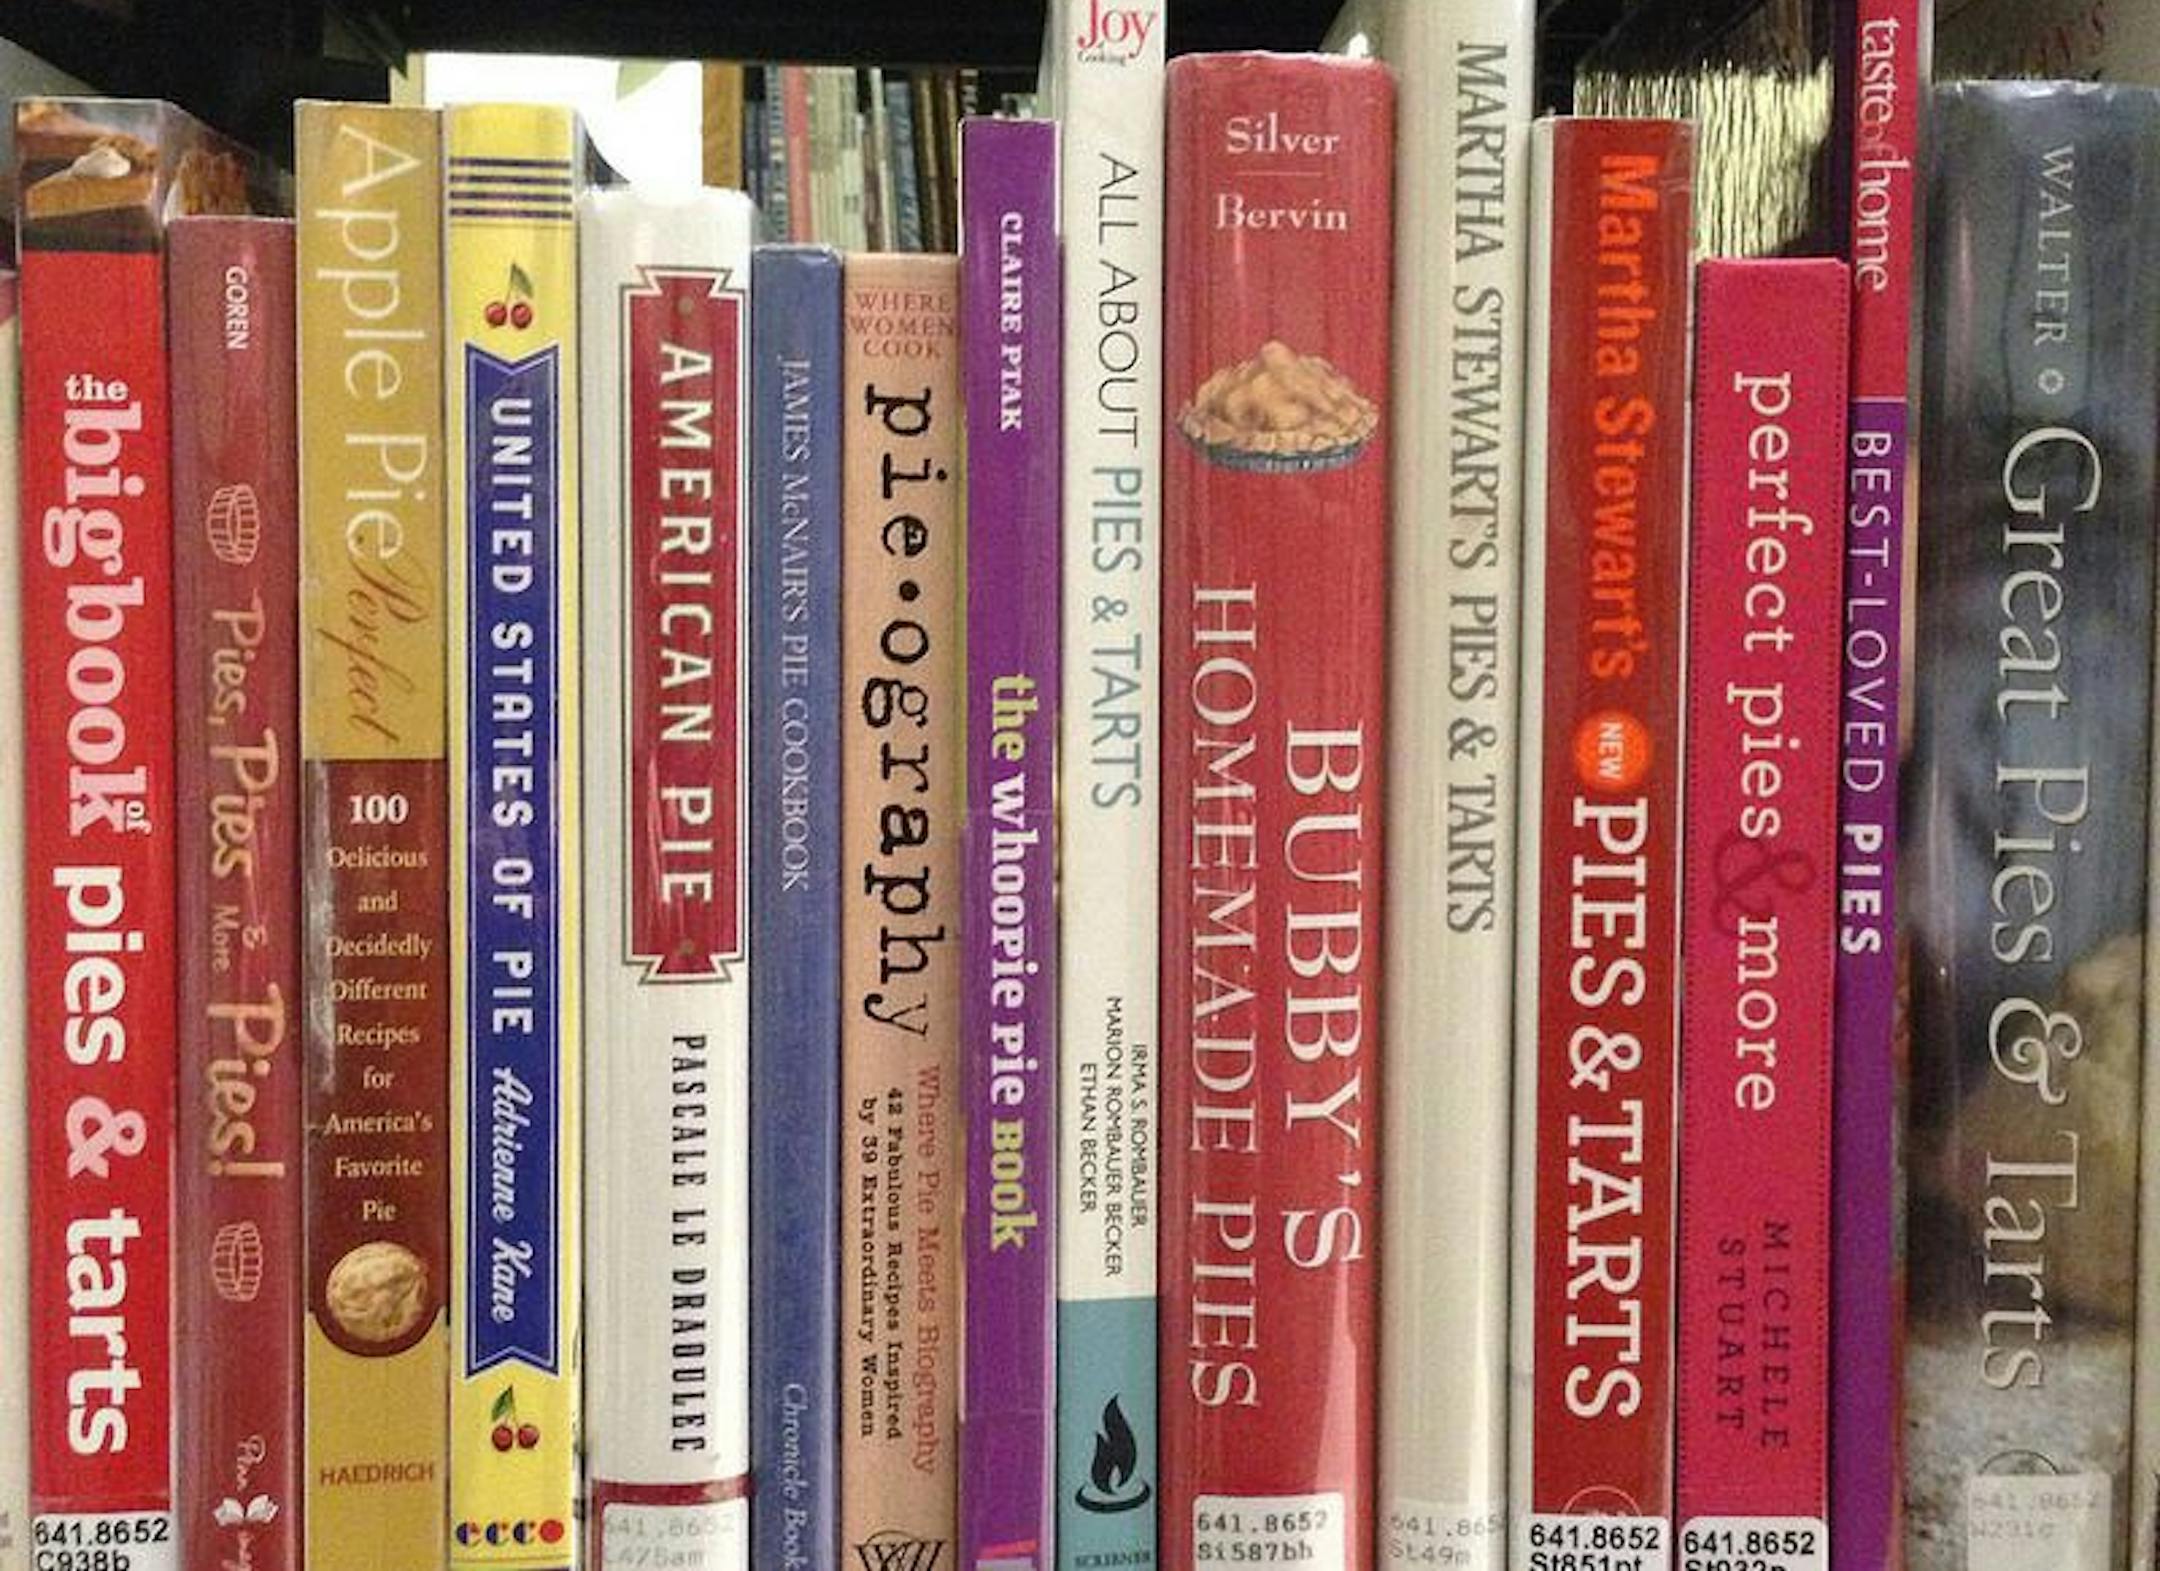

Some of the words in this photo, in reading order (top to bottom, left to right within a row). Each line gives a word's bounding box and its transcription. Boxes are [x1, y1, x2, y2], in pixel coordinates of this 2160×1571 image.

[1077, 0, 1158, 58] Joy
[1225, 113, 1340, 156] Silver
[1454, 43, 1508, 263] MARTHA
[1098, 152, 1139, 245] ALL
[1216, 193, 1348, 233] Bervin
[2032, 145, 2076, 347] WALTER
[225, 264, 250, 350] GOREN
[316, 122, 426, 400] Apple
[855, 291, 951, 313] WHERE
[1001, 211, 1024, 333] CLAIRE
[1598, 154, 1660, 375] Martha
[850, 317, 954, 336] WOMEN
[863, 340, 941, 359] COOK
[1098, 263, 1142, 449] ABOUT
[65, 373, 129, 402] the
[777, 357, 810, 460] JAMES
[1448, 285, 1504, 570] STEWART'S
[344, 431, 428, 558] Pie
[491, 397, 534, 593] UNITED
[660, 342, 714, 744] AMERICAN
[1091, 467, 1144, 573] PIES
[1590, 400, 1656, 680] Stewart's
[1733, 372, 1812, 653] perfect
[1091, 596, 1129, 623] &
[1842, 430, 1893, 794] BEST-LOVED
[1996, 427, 2102, 720] Great
[206, 587, 268, 724] Pies,
[318, 548, 428, 743] Perfect
[781, 632, 809, 688] PIE
[1447, 595, 1499, 707] PIES
[491, 622, 534, 825] STATES
[991, 674, 1038, 760] the
[1091, 632, 1143, 808] TARTS
[1447, 719, 1496, 762] &
[1598, 721, 1625, 783] NEW
[1727, 683, 1801, 838] pies
[208, 727, 280, 878] Pies
[348, 794, 409, 824] 100
[660, 785, 713, 904] PIE
[781, 696, 810, 891] COOKBOOK
[326, 844, 429, 870] Delicious
[357, 890, 399, 914] and
[491, 859, 534, 920] OF
[1191, 581, 1258, 1152] HOMEMADE
[1446, 774, 1498, 935] TARTS
[1570, 797, 1649, 1008] PIES
[1842, 823, 1883, 955] PIES
[1990, 767, 2091, 964] Pies
[53, 866, 144, 1065] pies
[325, 934, 433, 962] Decidedly
[328, 978, 429, 1003] Different
[491, 951, 534, 1034] PIE
[1281, 720, 1364, 1270] BUBBY'S
[336, 1021, 420, 1048] Recipes
[1104, 996, 1123, 1080] MARION
[1567, 1026, 1643, 1092] &
[1735, 916, 1780, 1112] more
[1987, 999, 2082, 1106] &
[205, 984, 286, 1179] Pies!
[363, 1067, 395, 1090] for
[671, 1034, 708, 1187] PASCALE
[856, 1097, 877, 1124] by
[885, 1087, 903, 1115] 42
[914, 1064, 940, 1156] Where
[1079, 1062, 1097, 1131] ETHAN
[1130, 1043, 1147, 1092] IRMA
[65, 1094, 147, 1179] &
[323, 1110, 434, 1136] America's
[334, 1155, 424, 1179] Favorite
[491, 1066, 536, 1222] Adrienne
[858, 1136, 877, 1164] 39
[1104, 1086, 1122, 1196] ROMBAUER
[1130, 1117, 1147, 1229] ROMBAUER
[362, 1199, 397, 1223] Pie
[671, 1208, 708, 1242] LE
[884, 1127, 903, 1229] Fabulous
[915, 1170, 940, 1213] Pie
[1078, 1138, 1096, 1214] BECKER
[491, 1236, 536, 1325] Kane
[855, 1175, 877, 1342] Extraordinary
[880, 1242, 903, 1330] Recipes
[915, 1228, 940, 1312] Meets
[1103, 1203, 1122, 1278] BECKER
[1565, 1099, 1643, 1418] TARTS
[1980, 1131, 2080, 1390] Tarts
[65, 1208, 143, 1456] tarts
[1190, 1196, 1258, 1410] PIES
[1717, 1236, 1745, 1431] STUART
[1761, 1220, 1790, 1451] MICHELE
[671, 1261, 708, 1453] DRAOULEC
[858, 1354, 877, 1438] Women
[880, 1341, 903, 1441] Inspired
[910, 1326, 940, 1476] Biography
[319, 1461, 435, 1487] HAEDRICH
[780, 1383, 808, 1500] Chronicle
[34, 1518, 169, 1547] 641.8652
[1197, 1511, 1331, 1533] 641.8652
[1530, 1523, 1660, 1550] 641.8652
[1684, 1531, 1815, 1554] 641.8652
